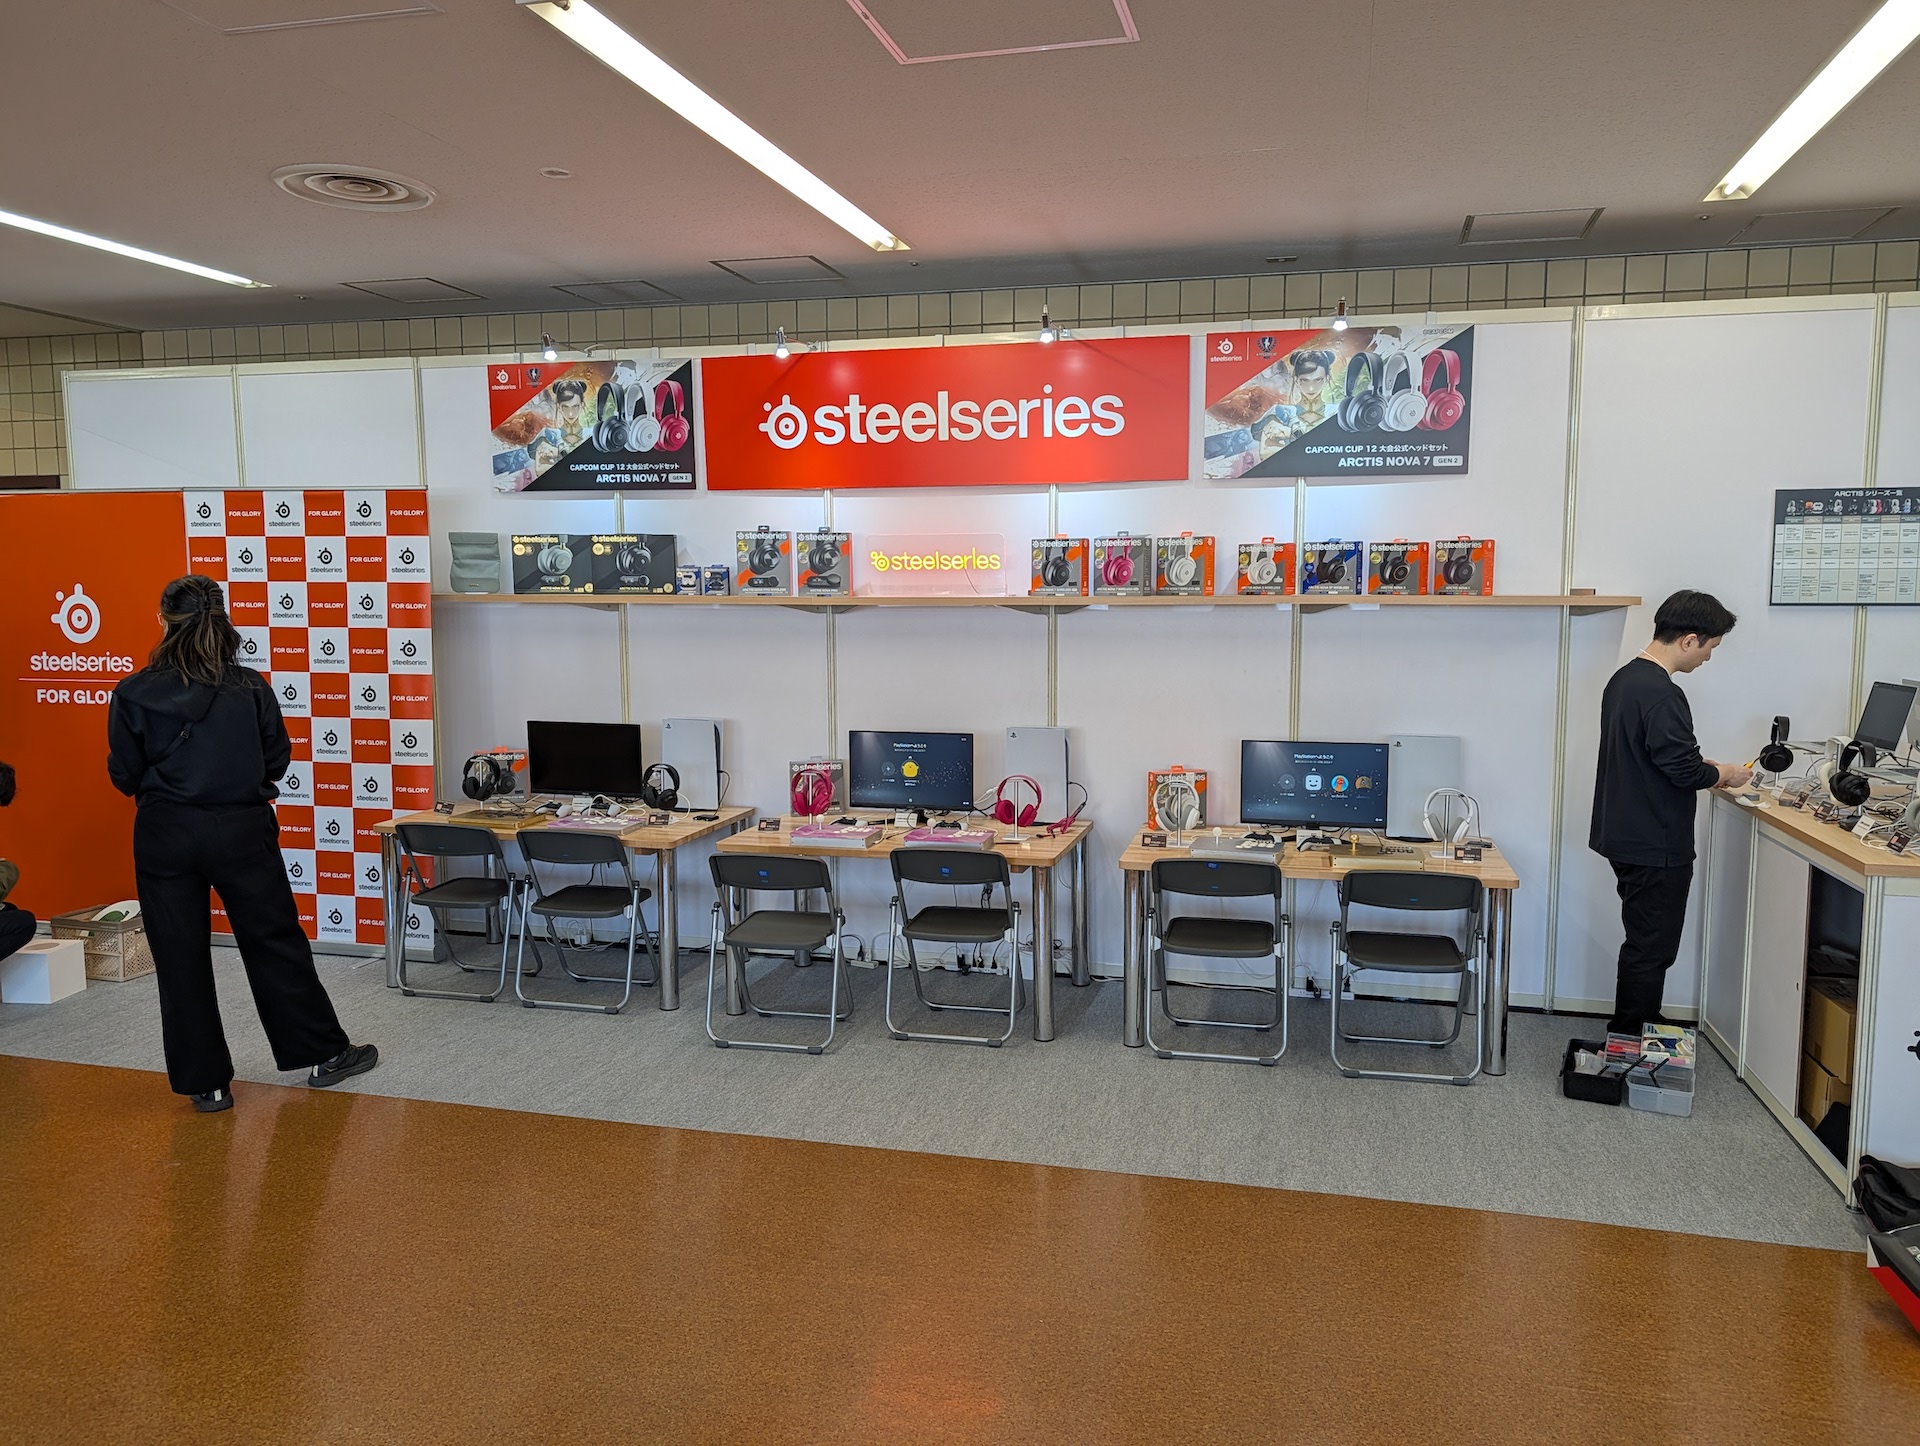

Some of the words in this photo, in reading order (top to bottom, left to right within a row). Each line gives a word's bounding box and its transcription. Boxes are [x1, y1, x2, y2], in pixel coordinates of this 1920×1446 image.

[814, 384, 1125, 445] steelseries
[1379, 444, 1448, 452] 大会公式ヘッドセット
[1338, 457, 1384, 467] ARCTIS
[1386, 457, 1420, 466] NOVA
[1423, 457, 1430, 466] 7
[596, 474, 631, 483] ARCTIS
[632, 474, 659, 483] NOVA
[660, 474, 666, 483] 7
[30, 652, 134, 672] steelseries
[36, 689, 70, 703] FOR
[74, 690, 113, 704] GLO
